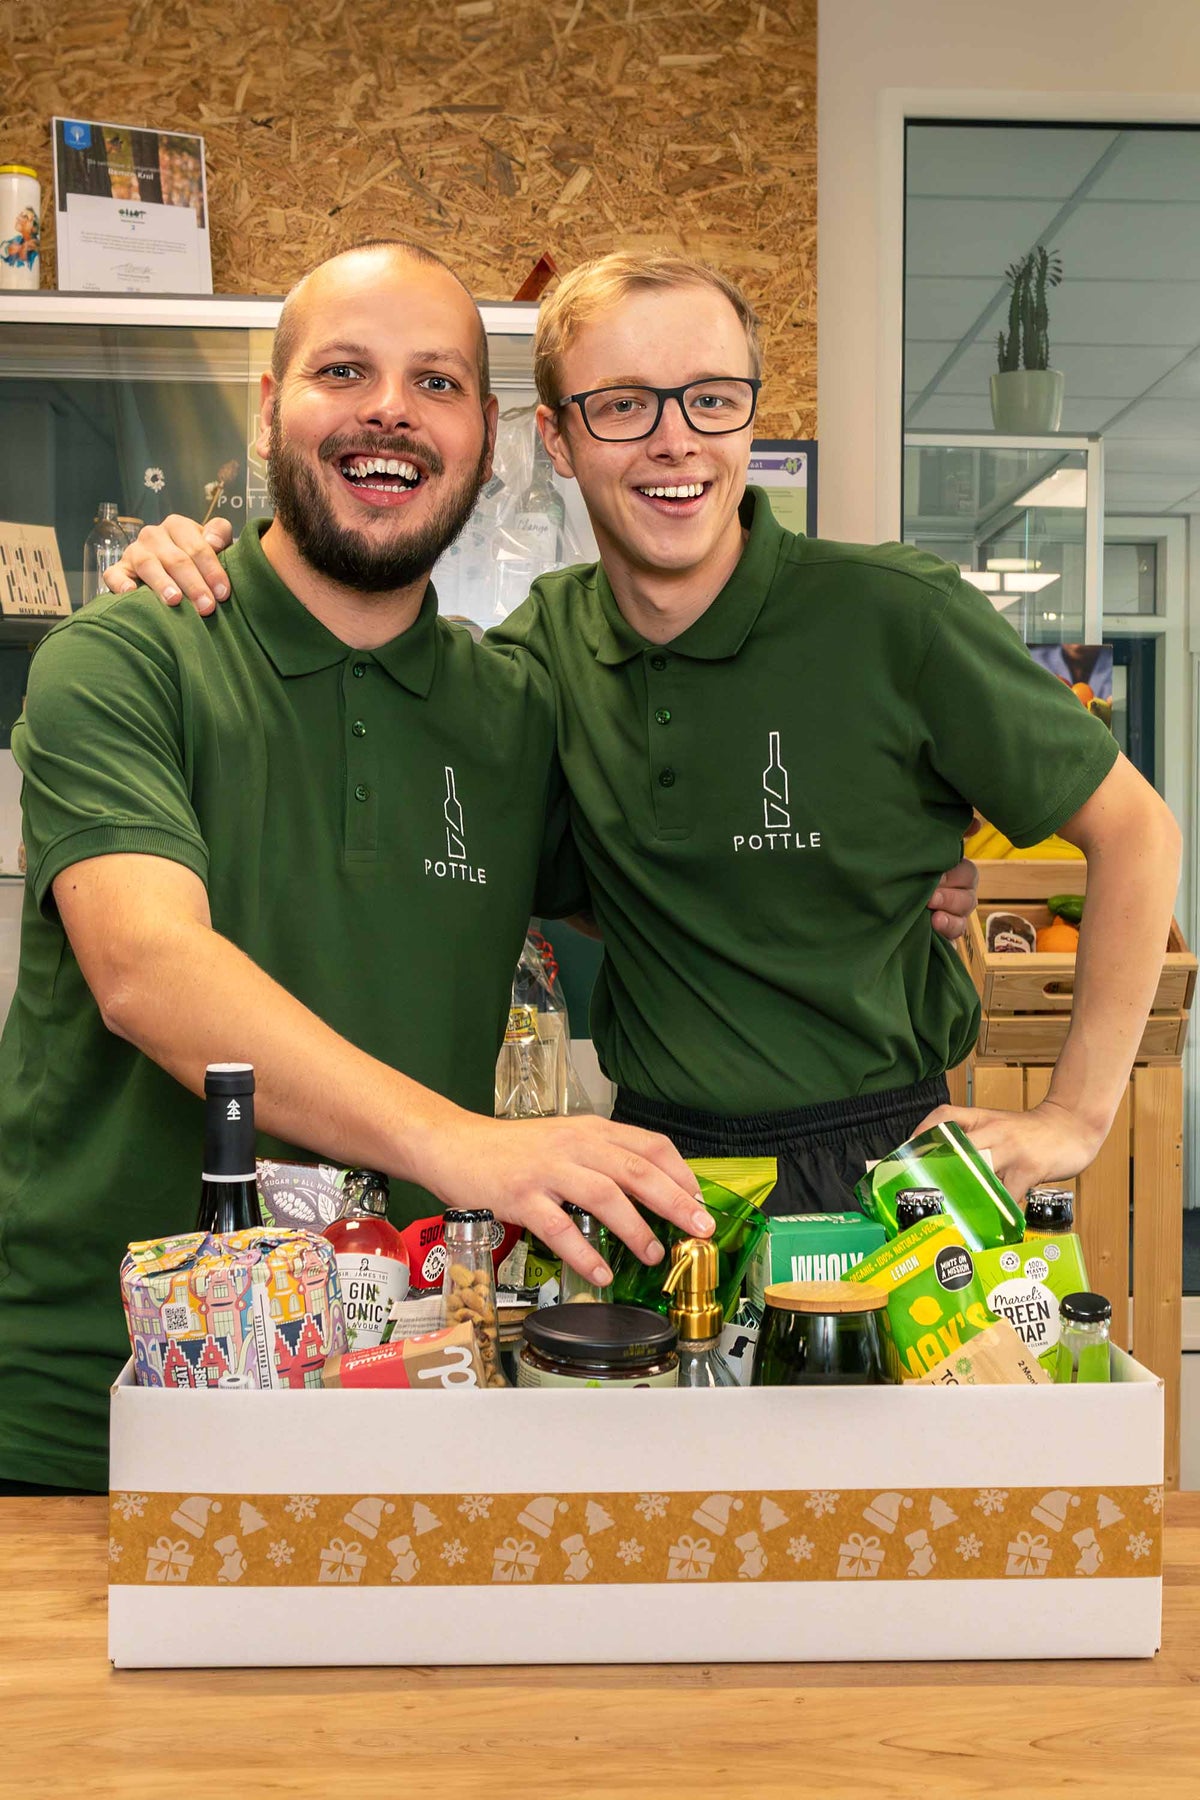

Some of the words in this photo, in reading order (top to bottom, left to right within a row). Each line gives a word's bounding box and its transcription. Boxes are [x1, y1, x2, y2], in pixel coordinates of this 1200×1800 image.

[217, 495, 269, 509] POTT
[733, 831, 822, 852] POTTLE
[423, 858, 488, 885] POTTLE
[264, 1178, 290, 1187] SUGAR
[316, 1182, 344, 1201] NATURA
[892, 1233, 922, 1255] NATURAL
[889, 1254, 921, 1281] LEMON
[940, 1257, 958, 1271] MINTS
[958, 1254, 967, 1264] ON
[946, 1263, 970, 1277] MISSION
[349, 1281, 376, 1301] GIN
[994, 1286, 1042, 1308] Marcel's
[254, 1315, 264, 1337] LIVES
[346, 1321, 379, 1330] LAVOUR
[1014, 1322, 1046, 1343] OAP
[257, 1340, 268, 1368] CHANGE
[193, 1366, 209, 1389] USE
[1017, 1360, 1026, 1368] 2
[1022, 1366, 1039, 1385] Mon
